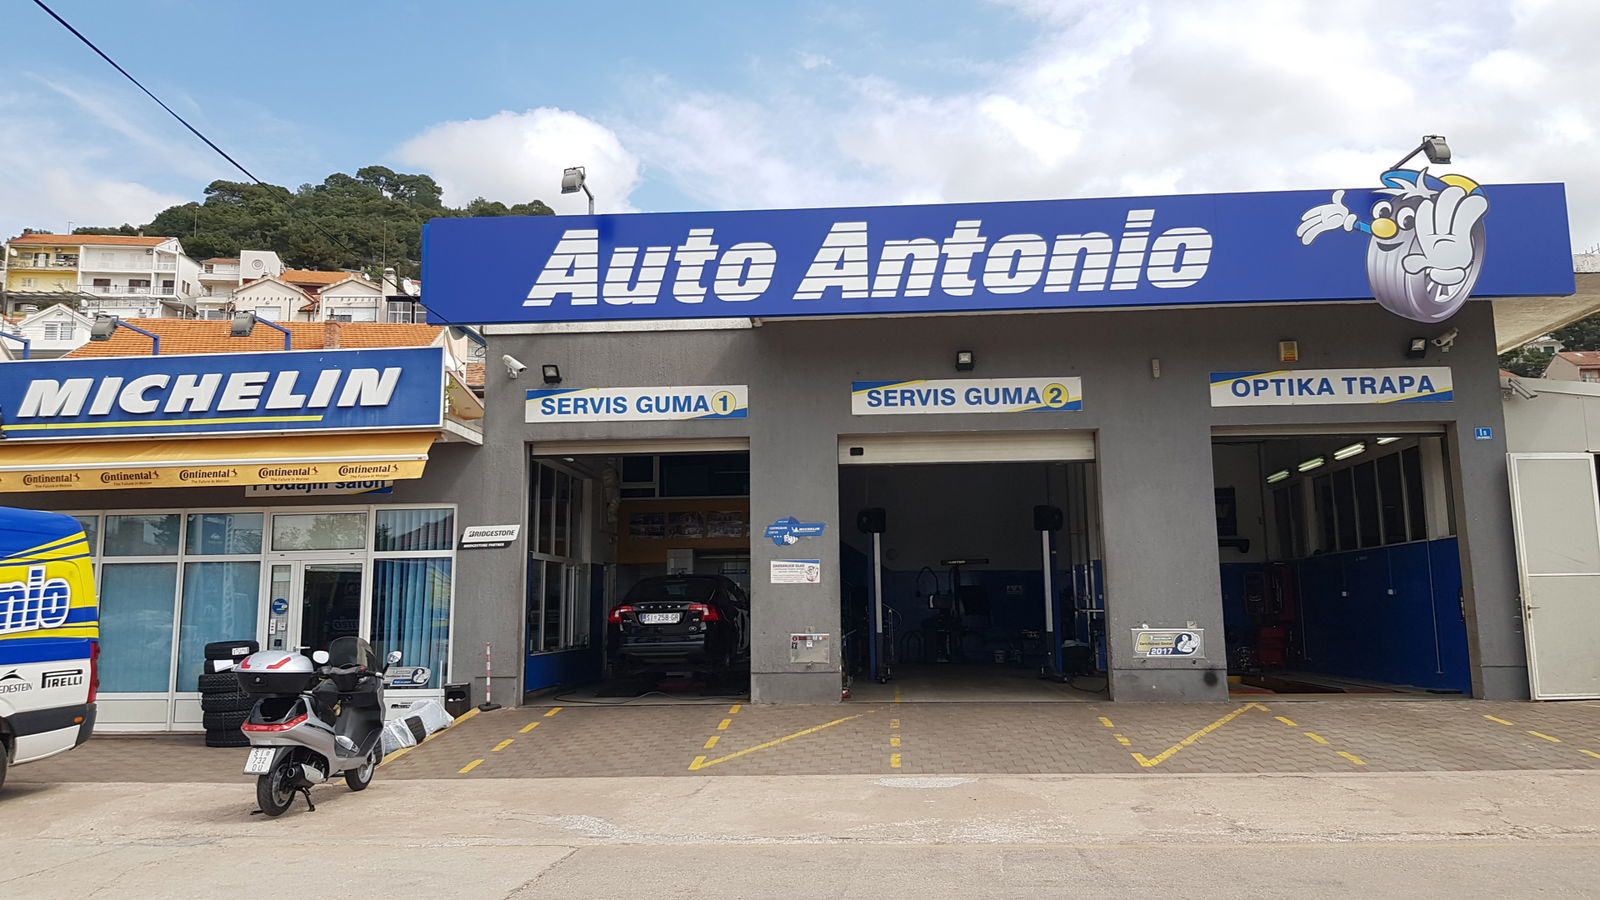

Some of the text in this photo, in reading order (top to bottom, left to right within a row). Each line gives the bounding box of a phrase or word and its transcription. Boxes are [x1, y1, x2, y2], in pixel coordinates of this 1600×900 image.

[522, 209, 1213, 306] Auto Antonio
[17, 367, 402, 418] MICHELIN
[1231, 375, 1436, 398] OPTIKA TRAPA
[541, 394, 729, 416] SERVIS GUMA 1
[867, 387, 1063, 407] SERVIS GUMA 2
[100, 470, 152, 484] Continental
[179, 468, 230, 481] Continental
[258, 466, 311, 479] Continental
[338, 464, 391, 477] Continental
[23, 473, 73, 486] Continental
[468, 530, 516, 538] BRIDGESTONE
[41, 669, 83, 689] PIRELLI
